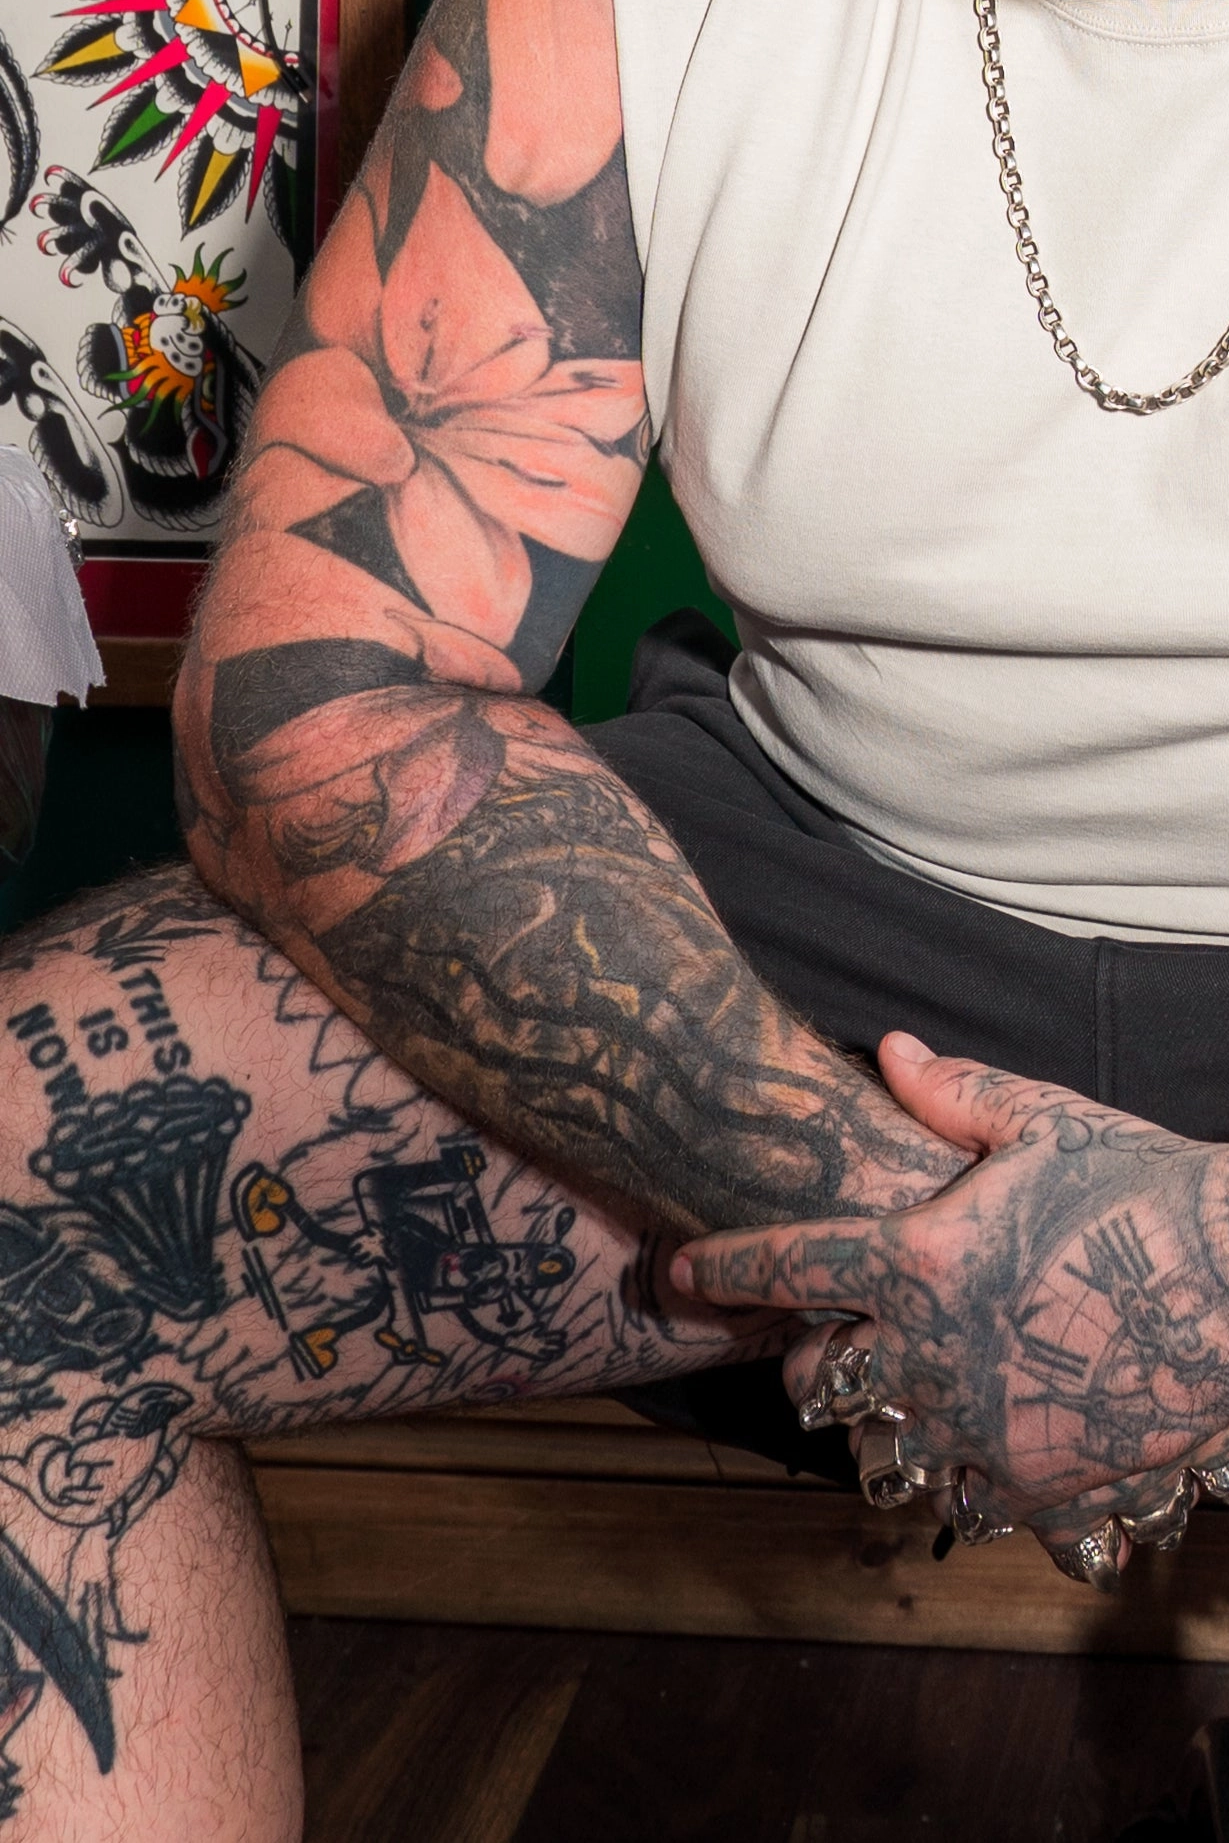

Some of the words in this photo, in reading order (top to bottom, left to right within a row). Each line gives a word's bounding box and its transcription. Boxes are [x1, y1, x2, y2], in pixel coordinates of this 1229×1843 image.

[6, 1002, 86, 1112] NOW
[79, 1002, 130, 1061] IS
[120, 965, 193, 1078] THIS
